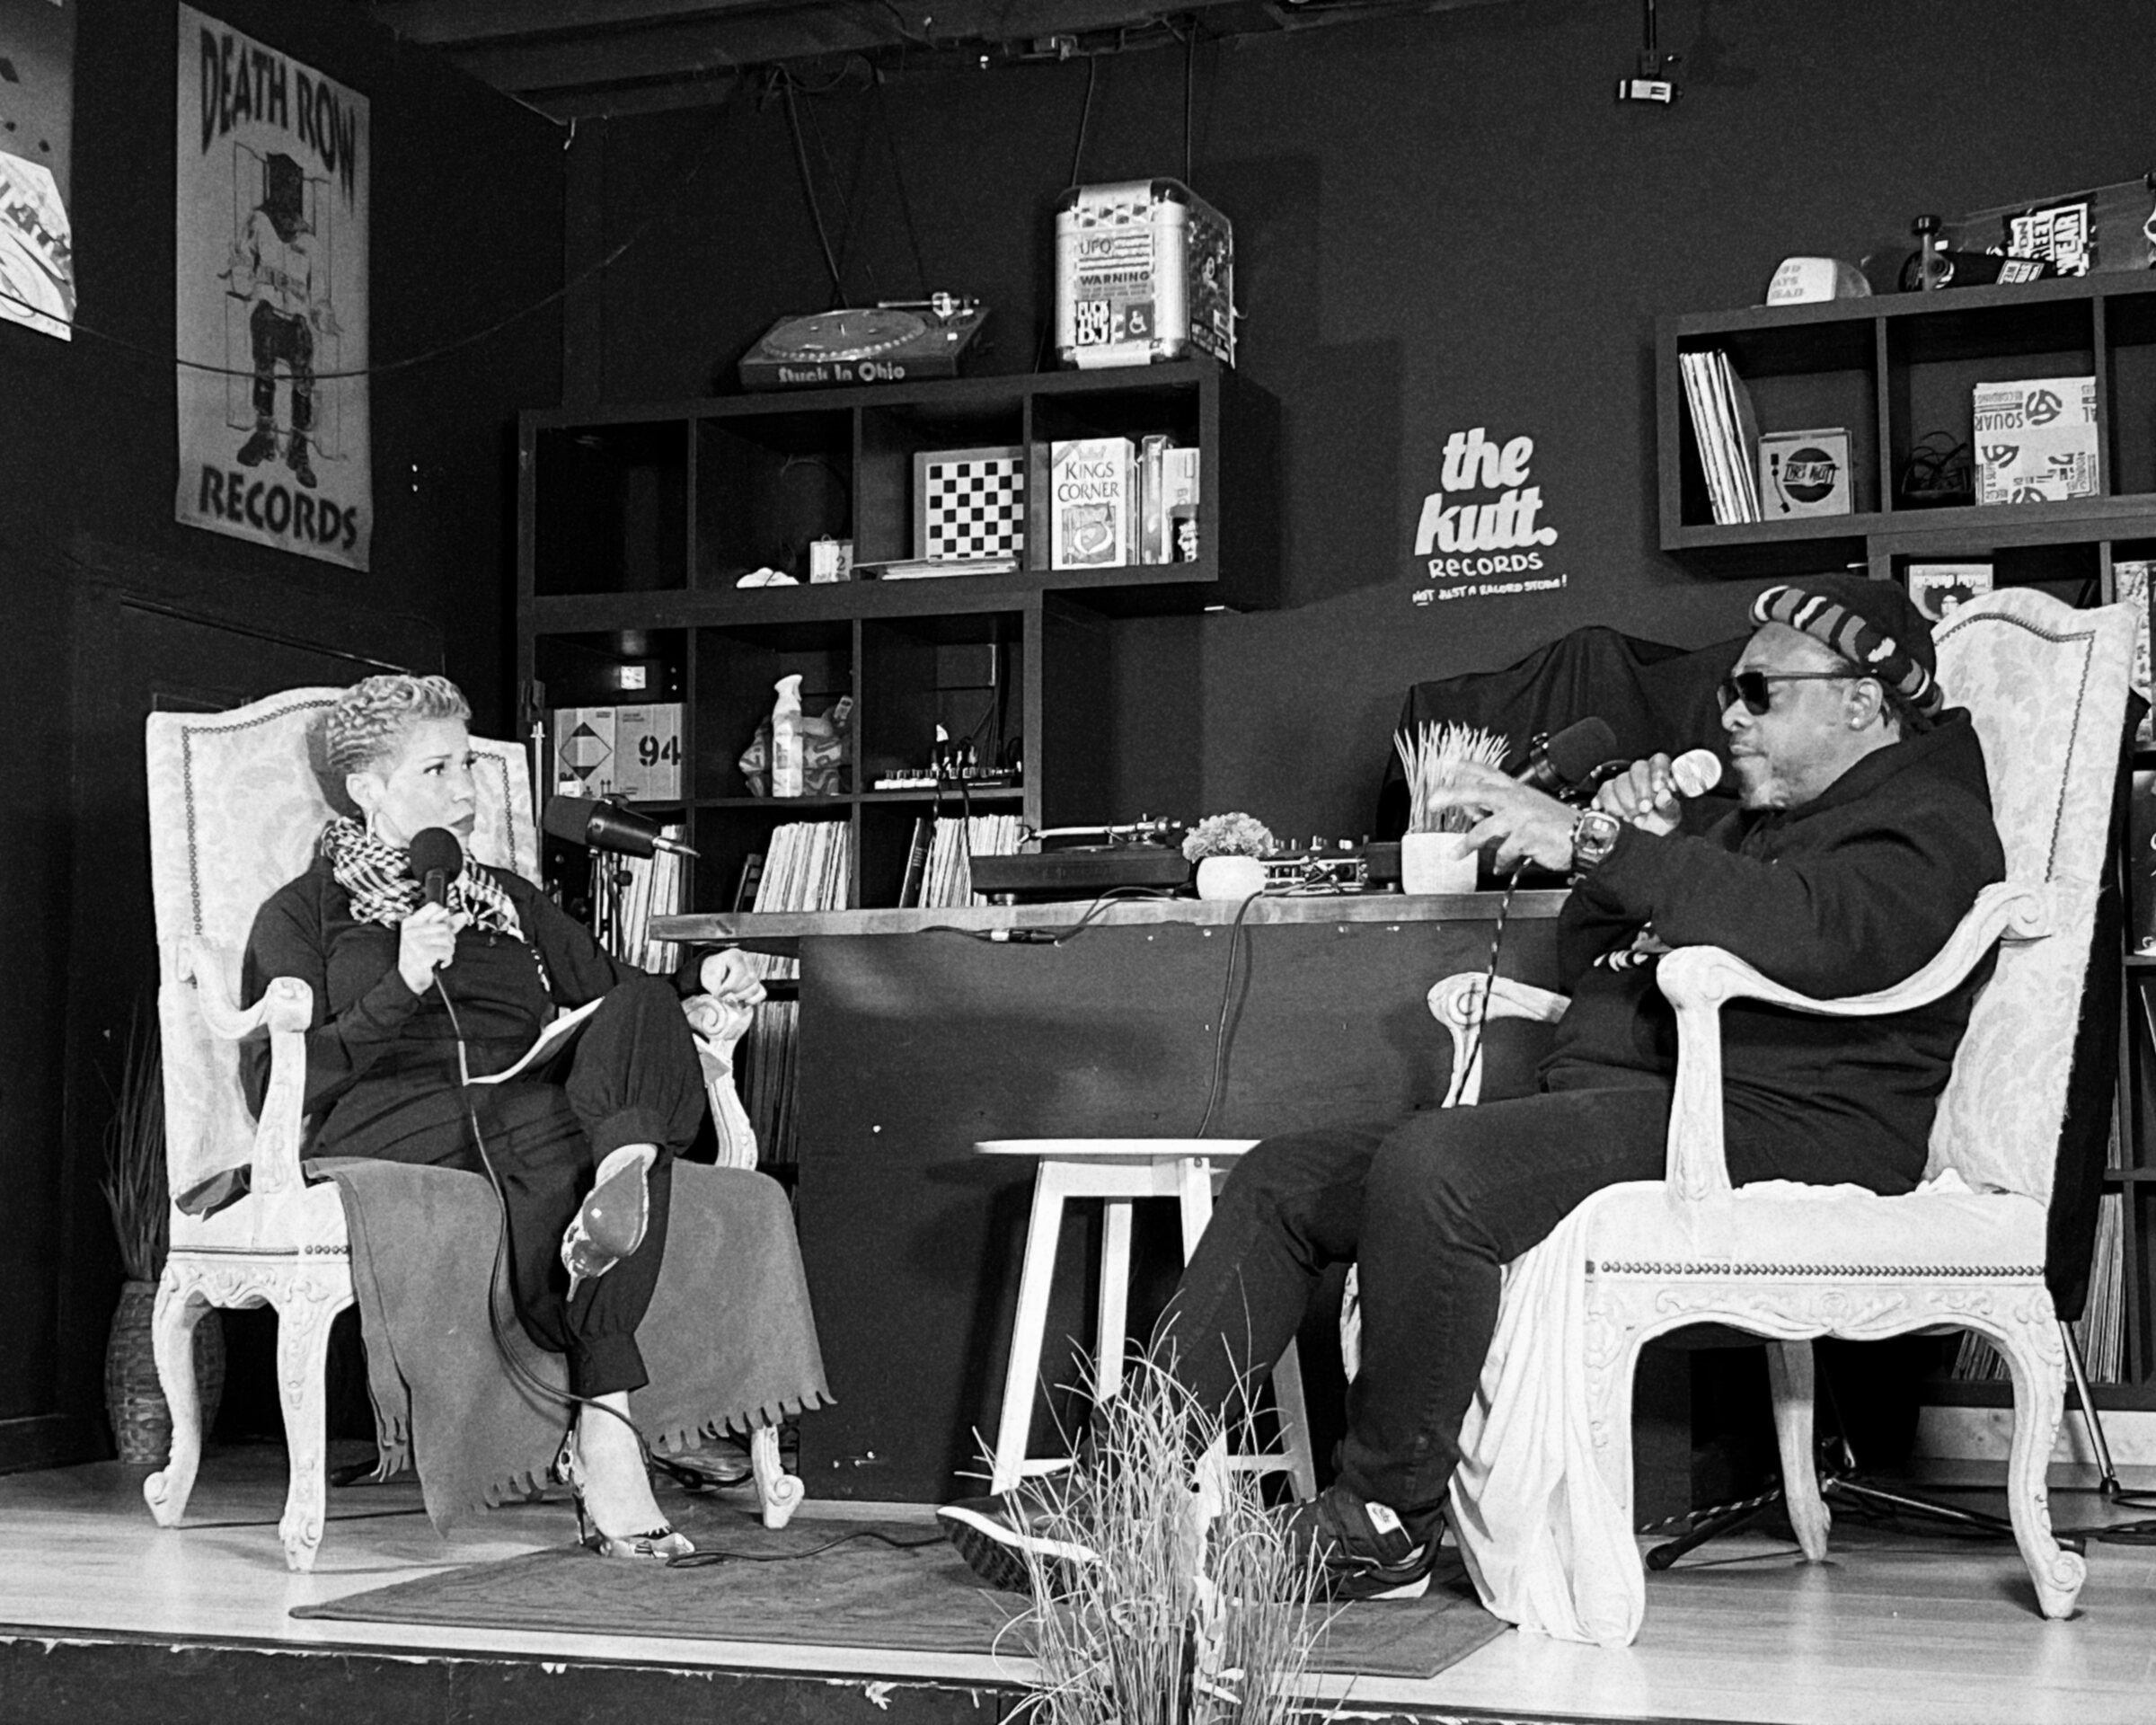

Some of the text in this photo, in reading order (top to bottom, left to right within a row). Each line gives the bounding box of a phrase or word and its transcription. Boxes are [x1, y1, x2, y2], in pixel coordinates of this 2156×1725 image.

[200, 25, 355, 221] DEATH ROW
[1080, 237, 1112, 255] UFO
[1079, 270, 1150, 286] WARNING
[1078, 325, 1109, 343] DJ
[835, 364, 853, 381] In
[858, 361, 906, 382] Ohio
[1441, 427, 1533, 492] the
[1065, 461, 1115, 481] KINGS
[1057, 482, 1120, 502] CORNER
[199, 464, 358, 551] RECORDS
[639, 735, 681, 766] 94
